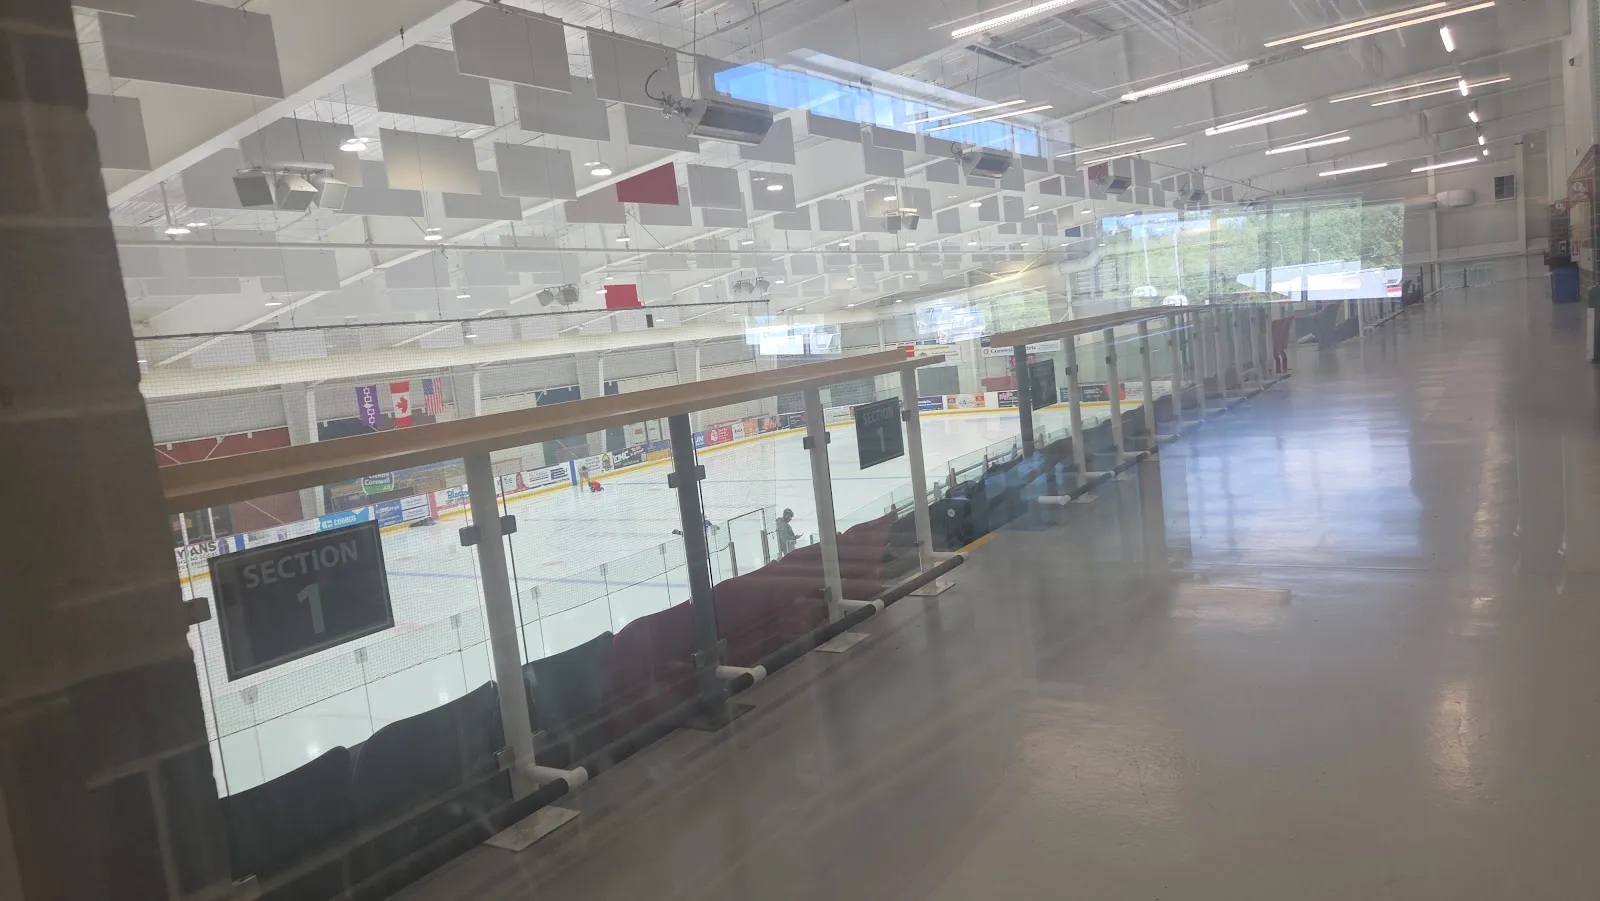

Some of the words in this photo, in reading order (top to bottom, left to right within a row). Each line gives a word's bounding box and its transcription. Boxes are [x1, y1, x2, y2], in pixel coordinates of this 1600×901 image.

[863, 406, 895, 427] SECTION
[876, 426, 886, 452] 1
[243, 540, 358, 589] SECTION
[297, 582, 325, 635] 1
